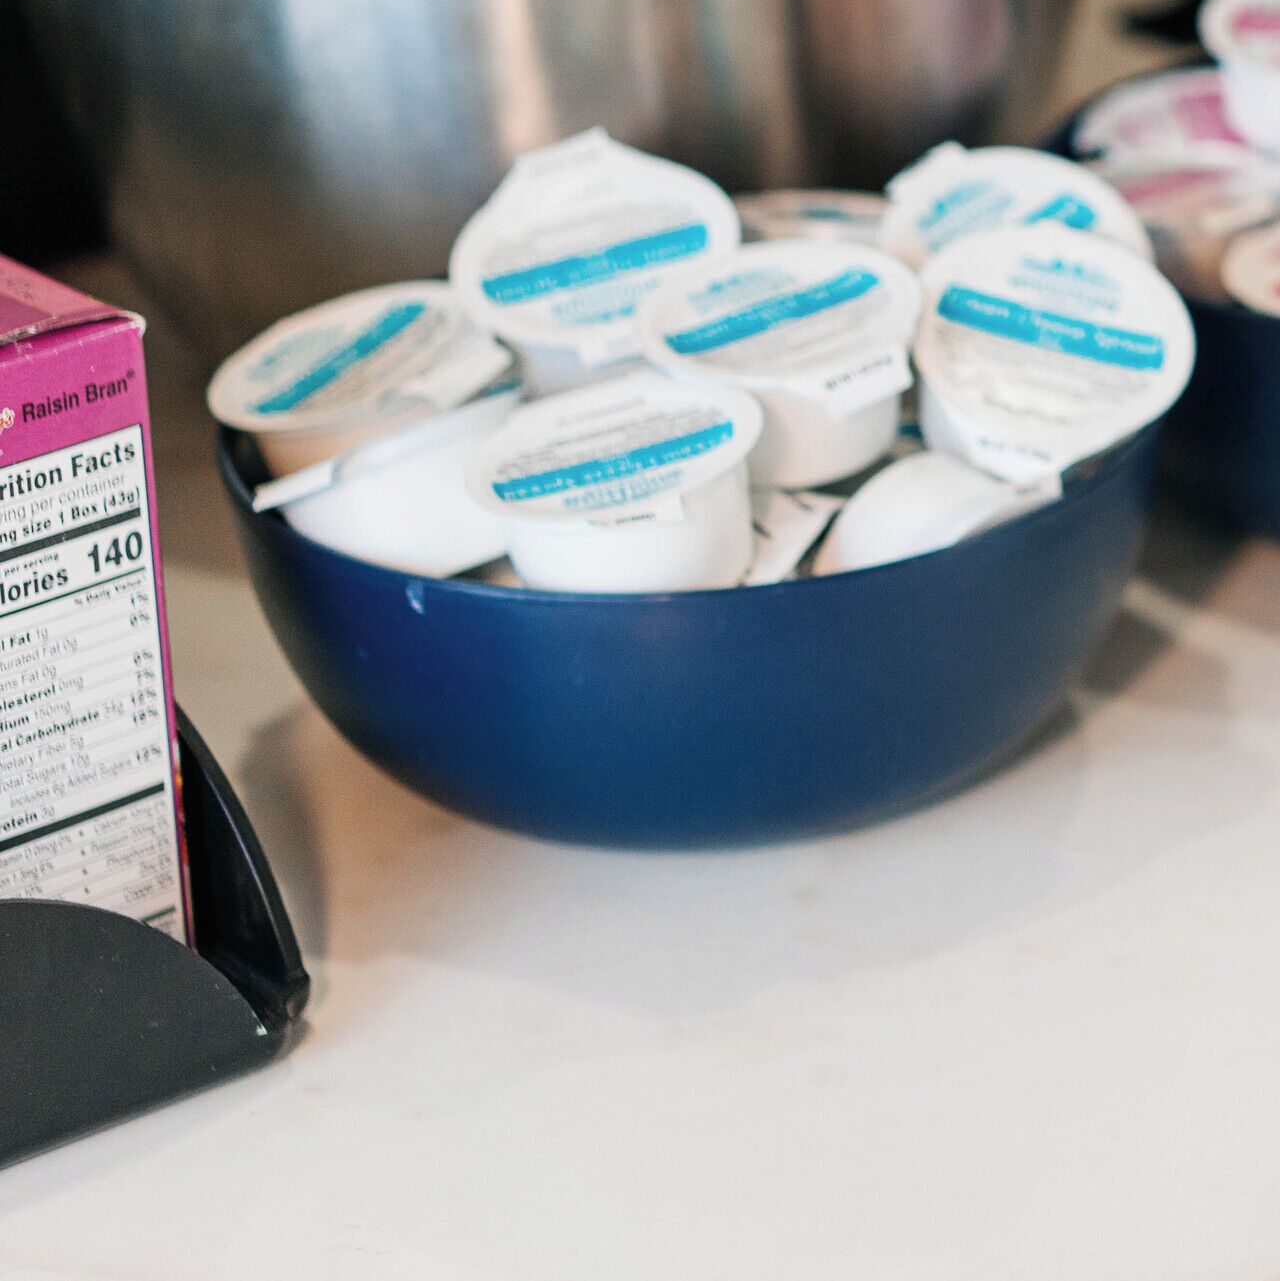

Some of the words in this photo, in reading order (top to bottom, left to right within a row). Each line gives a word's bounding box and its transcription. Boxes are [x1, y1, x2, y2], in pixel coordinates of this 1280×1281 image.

[22, 391, 80, 422] Raisin
[70, 442, 136, 478] Facts
[30, 496, 54, 519] per
[58, 475, 125, 505] container
[22, 519, 52, 537] size
[59, 510, 65, 525] 1
[71, 503, 98, 521] Box
[23, 553, 59, 571] serving
[87, 531, 143, 574] 140
[9, 631, 31, 648] Fat
[0, 683, 56, 711] lesterol
